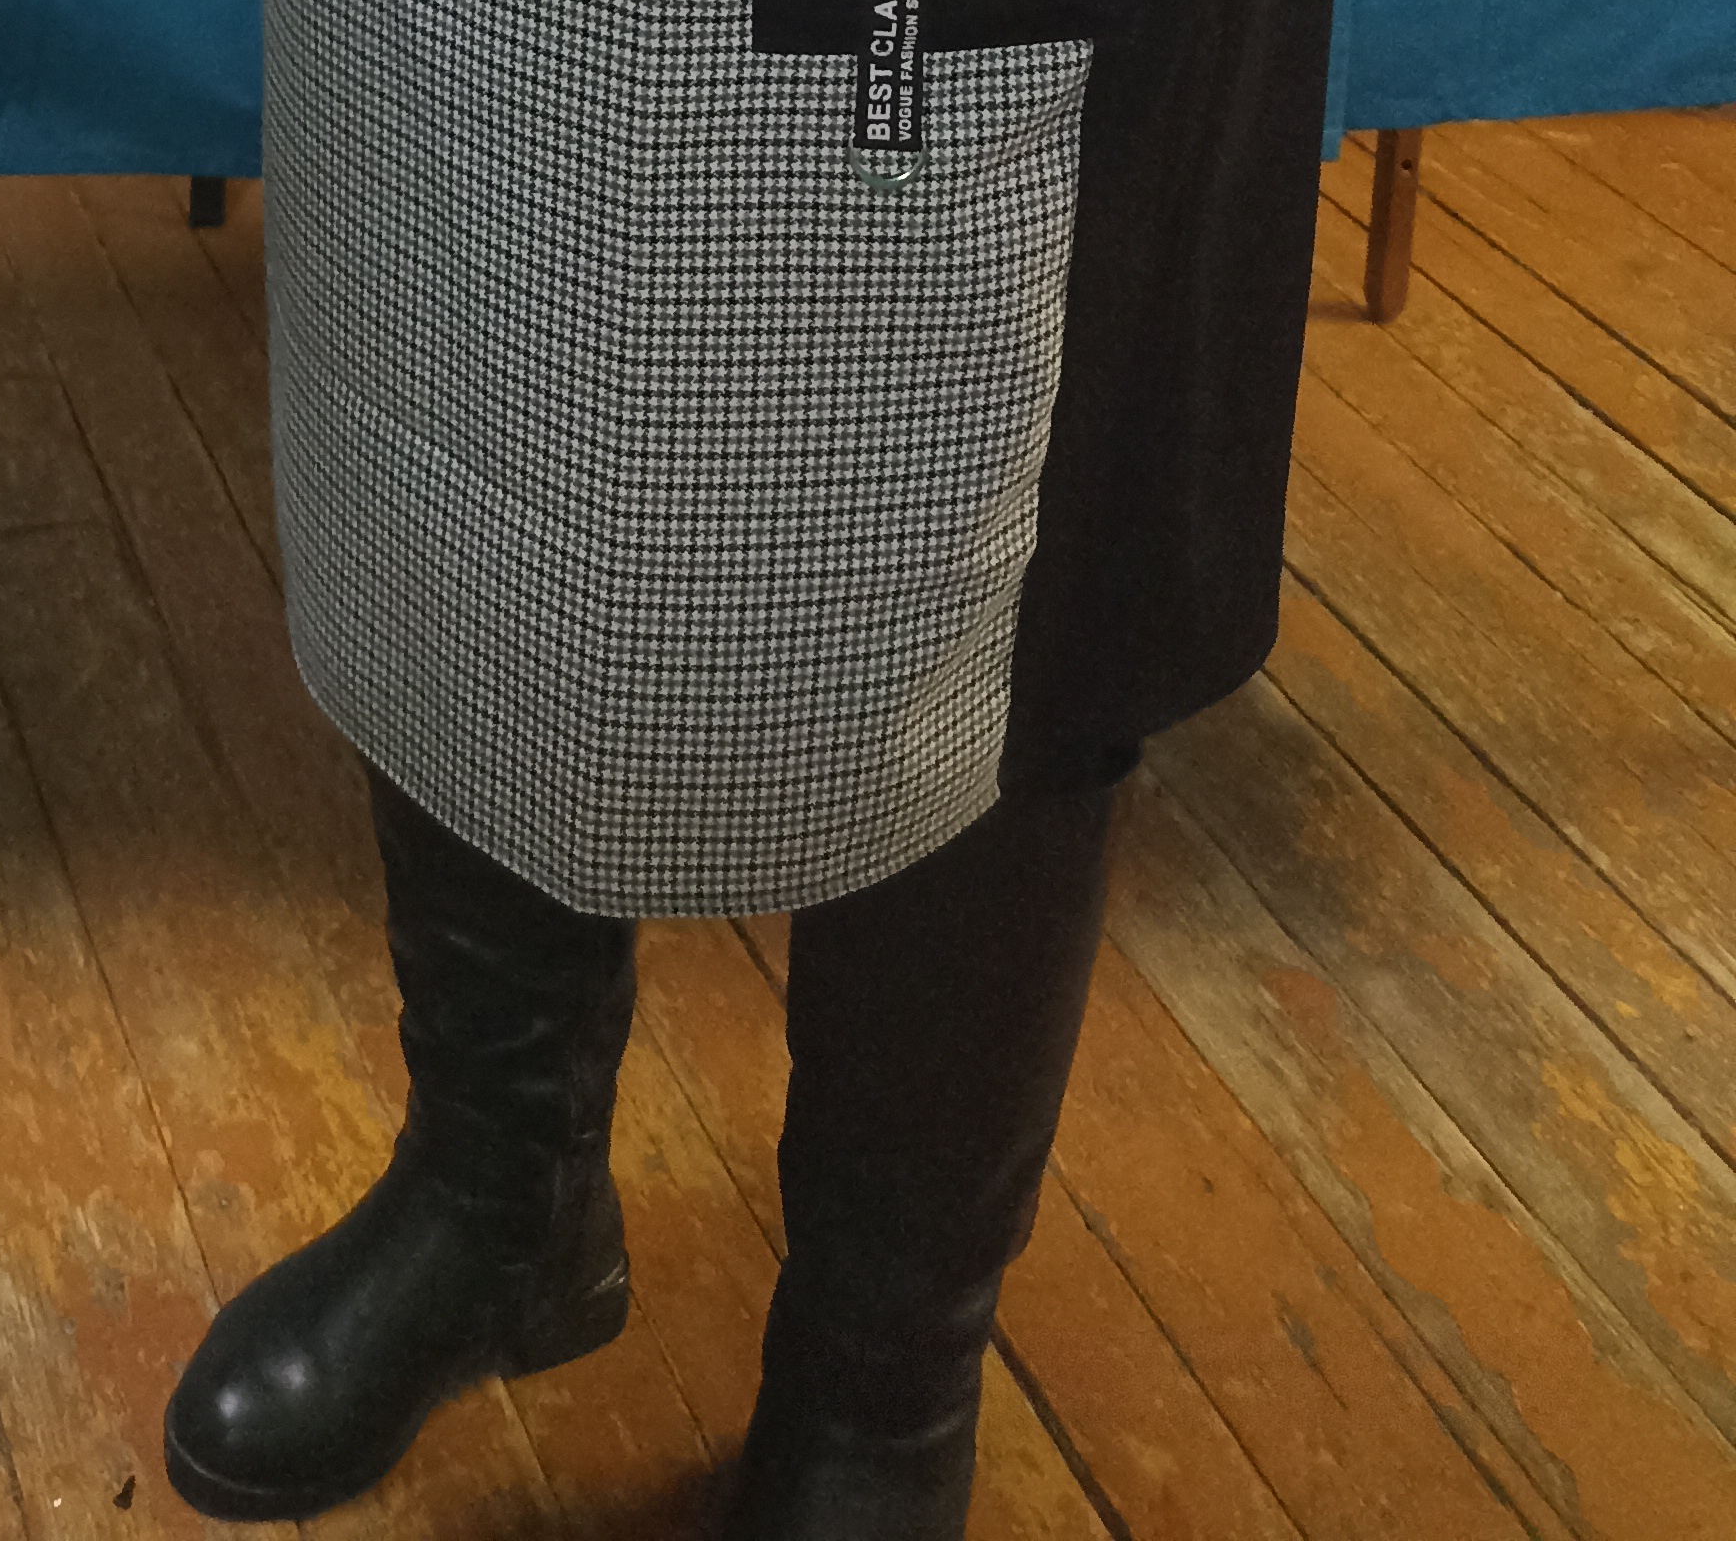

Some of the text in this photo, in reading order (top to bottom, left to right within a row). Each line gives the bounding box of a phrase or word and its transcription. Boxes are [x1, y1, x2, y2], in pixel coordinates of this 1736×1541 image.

[899, 14, 920, 81] FASHION
[866, 63, 894, 142] BEST
[898, 84, 914, 142] VOGUE
